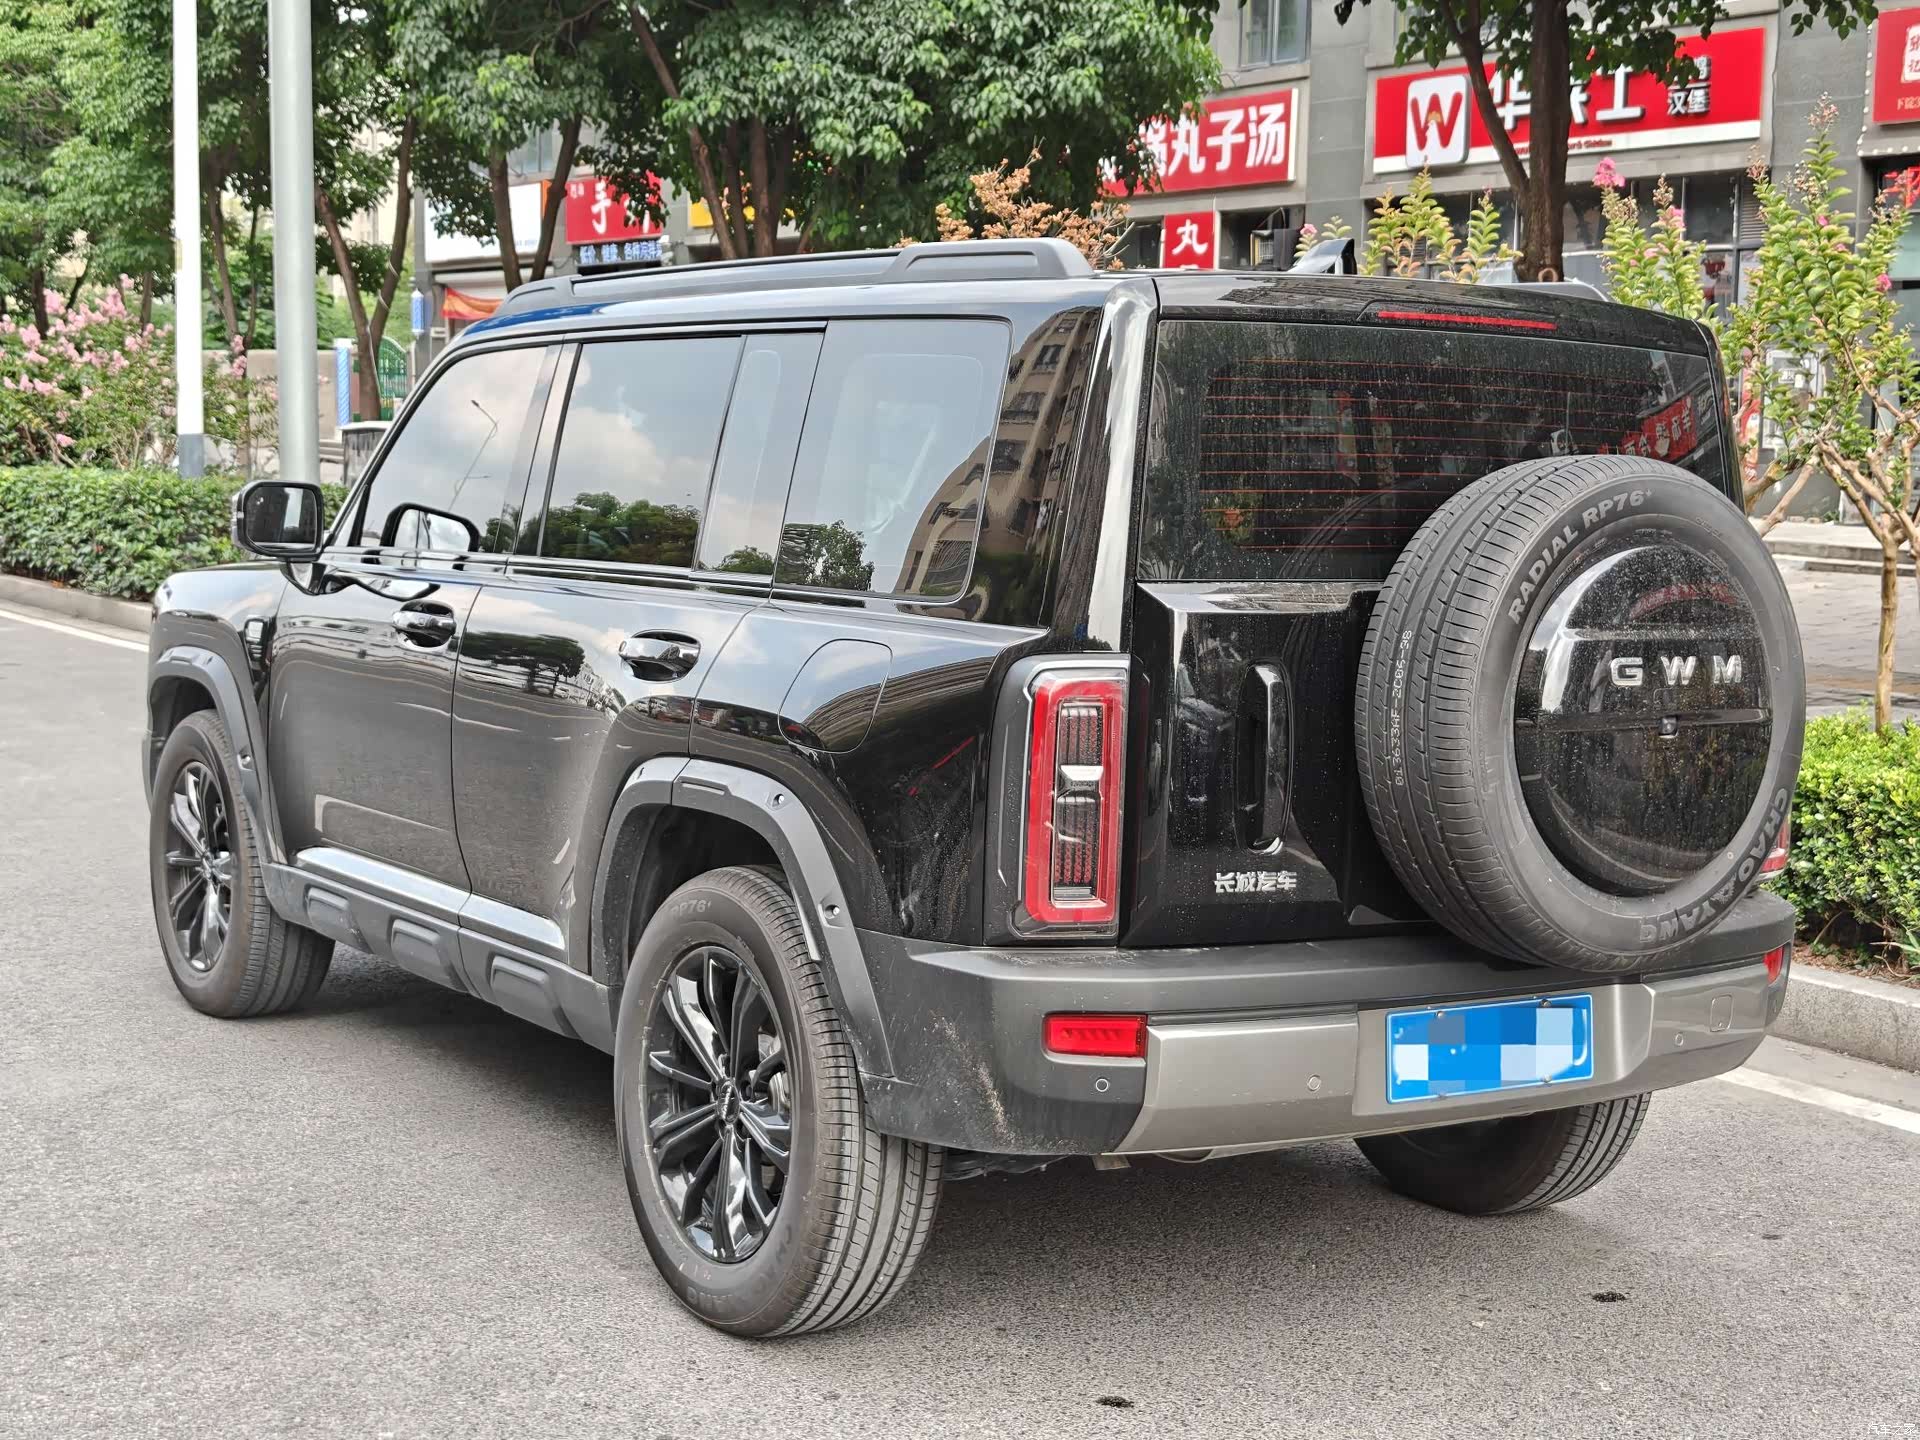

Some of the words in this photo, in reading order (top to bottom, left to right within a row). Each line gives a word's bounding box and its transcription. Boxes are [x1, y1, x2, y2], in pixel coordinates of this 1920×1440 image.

[1667, 88, 1711, 115] 汉堡
[1508, 525, 1579, 624] RADIAL
[1214, 870, 1298, 894] 长城汽车
